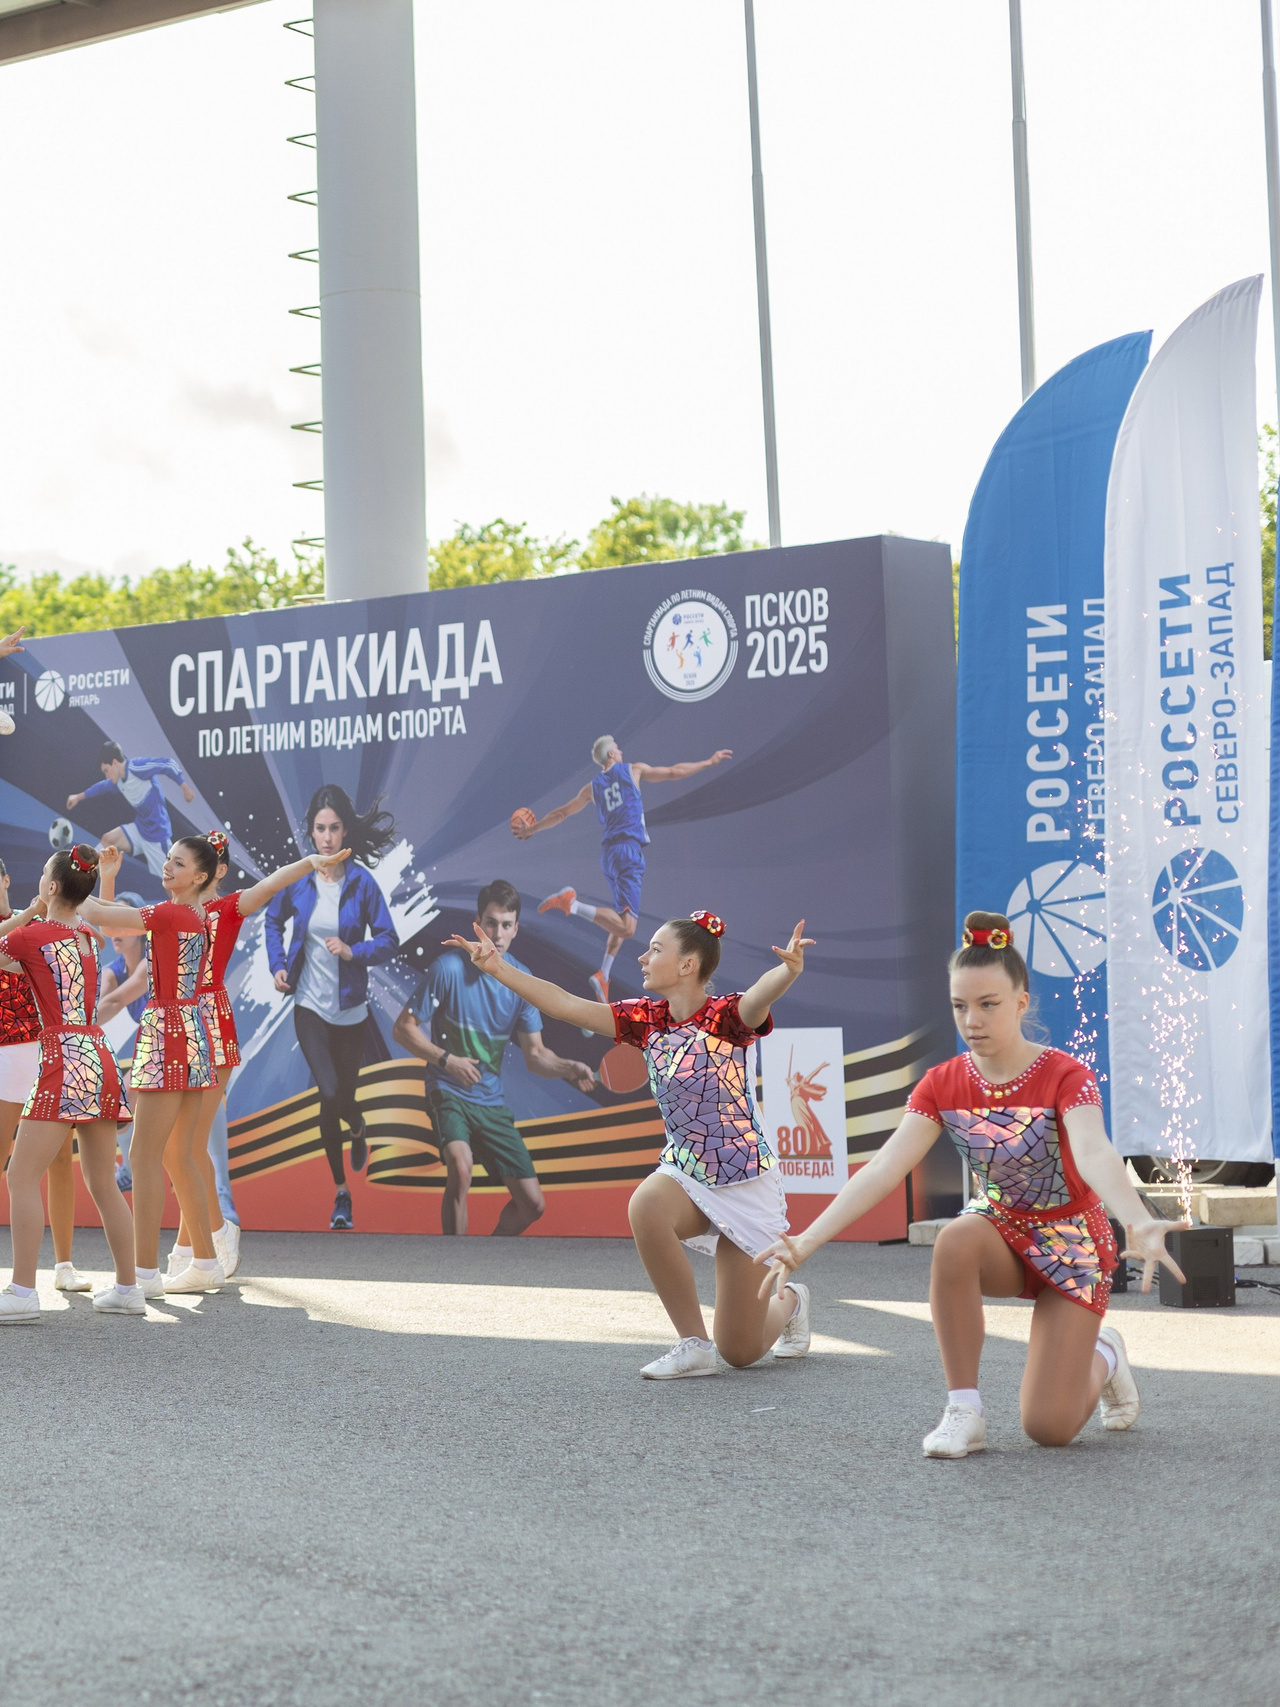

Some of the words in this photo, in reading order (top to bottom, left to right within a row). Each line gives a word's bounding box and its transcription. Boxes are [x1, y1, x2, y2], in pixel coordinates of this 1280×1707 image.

[643, 599, 672, 646] СПАРТАКИАДА
[670, 592, 681, 604] ПО
[681, 589, 707, 600] ЛЕТНИМ
[705, 592, 727, 613] ВИДАМ
[723, 610, 738, 638] СПОРТА
[745, 587, 829, 629] ПСКОВ
[170, 619, 503, 717] СПАРТАКИАДА
[746, 624, 829, 679] 2025
[68, 668, 130, 691] РОССЕТИ
[69, 694, 100, 707] ЯНТАРЬ
[1159, 574, 1201, 828] РОССЕТИ
[1206, 562, 1240, 824] СЕВЕРО-ЗАПАД
[198, 729, 222, 758] ПО
[227, 720, 305, 755] ЛЕТНИМ
[311, 713, 382, 750] ВИДАМ
[387, 705, 467, 741] СПОРТА
[1026, 604, 1070, 842] РОССЕТИ
[777, 1125, 807, 1155] 80
[778, 1161, 834, 1179] ПОБЕДА!
